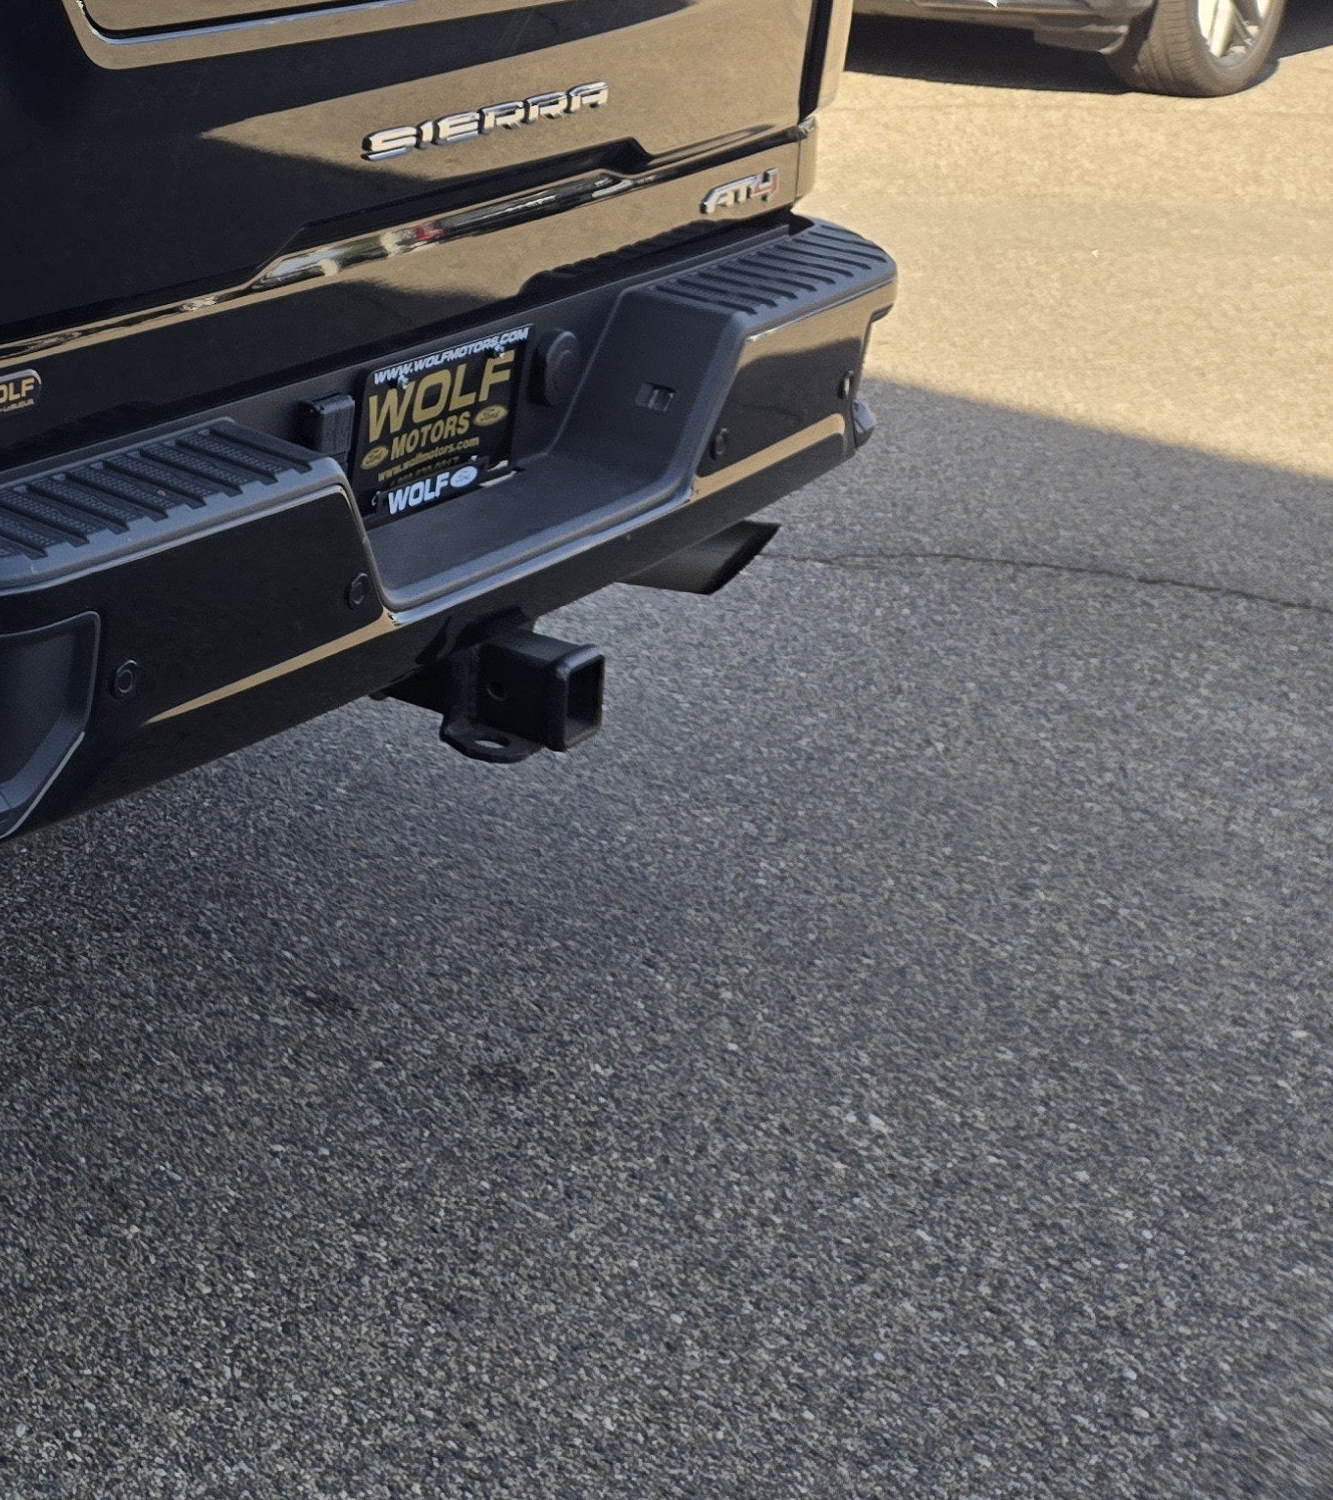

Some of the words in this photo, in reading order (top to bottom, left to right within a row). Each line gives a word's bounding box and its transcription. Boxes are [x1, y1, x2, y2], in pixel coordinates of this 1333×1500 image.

[361, 80, 610, 161] SIERRA
[700, 167, 780, 214] AT4
[368, 349, 516, 444] WOLF
[389, 410, 471, 461] MOTORS
[387, 471, 451, 515] WOLF
